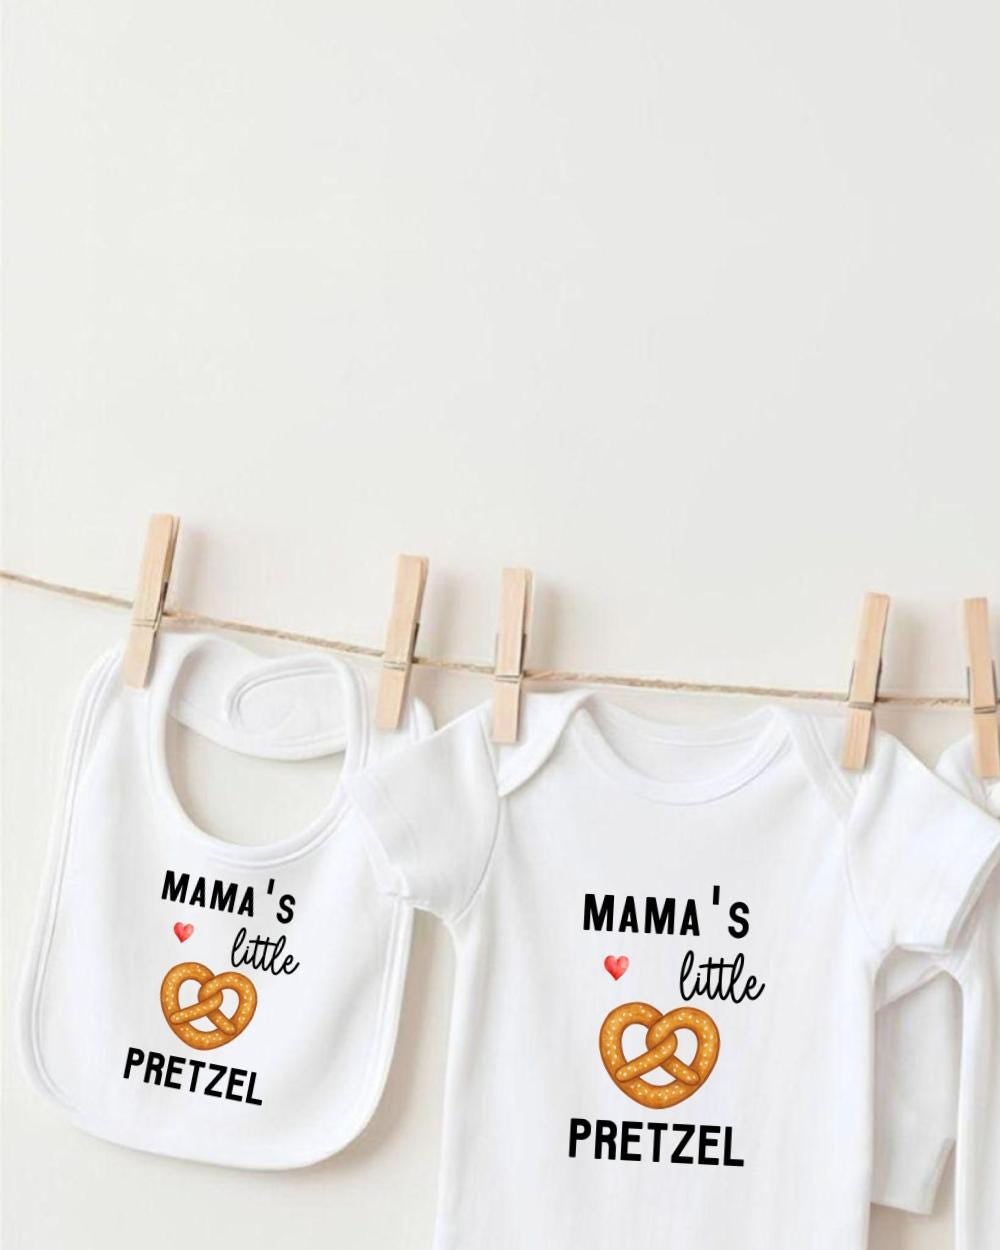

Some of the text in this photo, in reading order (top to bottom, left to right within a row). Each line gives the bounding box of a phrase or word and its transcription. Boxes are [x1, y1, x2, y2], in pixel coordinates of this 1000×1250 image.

[161, 870, 295, 924] MAMA'S
[583, 885, 749, 939] MAMA'S
[231, 927, 300, 975] little
[680, 950, 765, 1004] little
[124, 1047, 262, 1105] PRETZEL
[569, 1118, 744, 1167] PRETZEL
